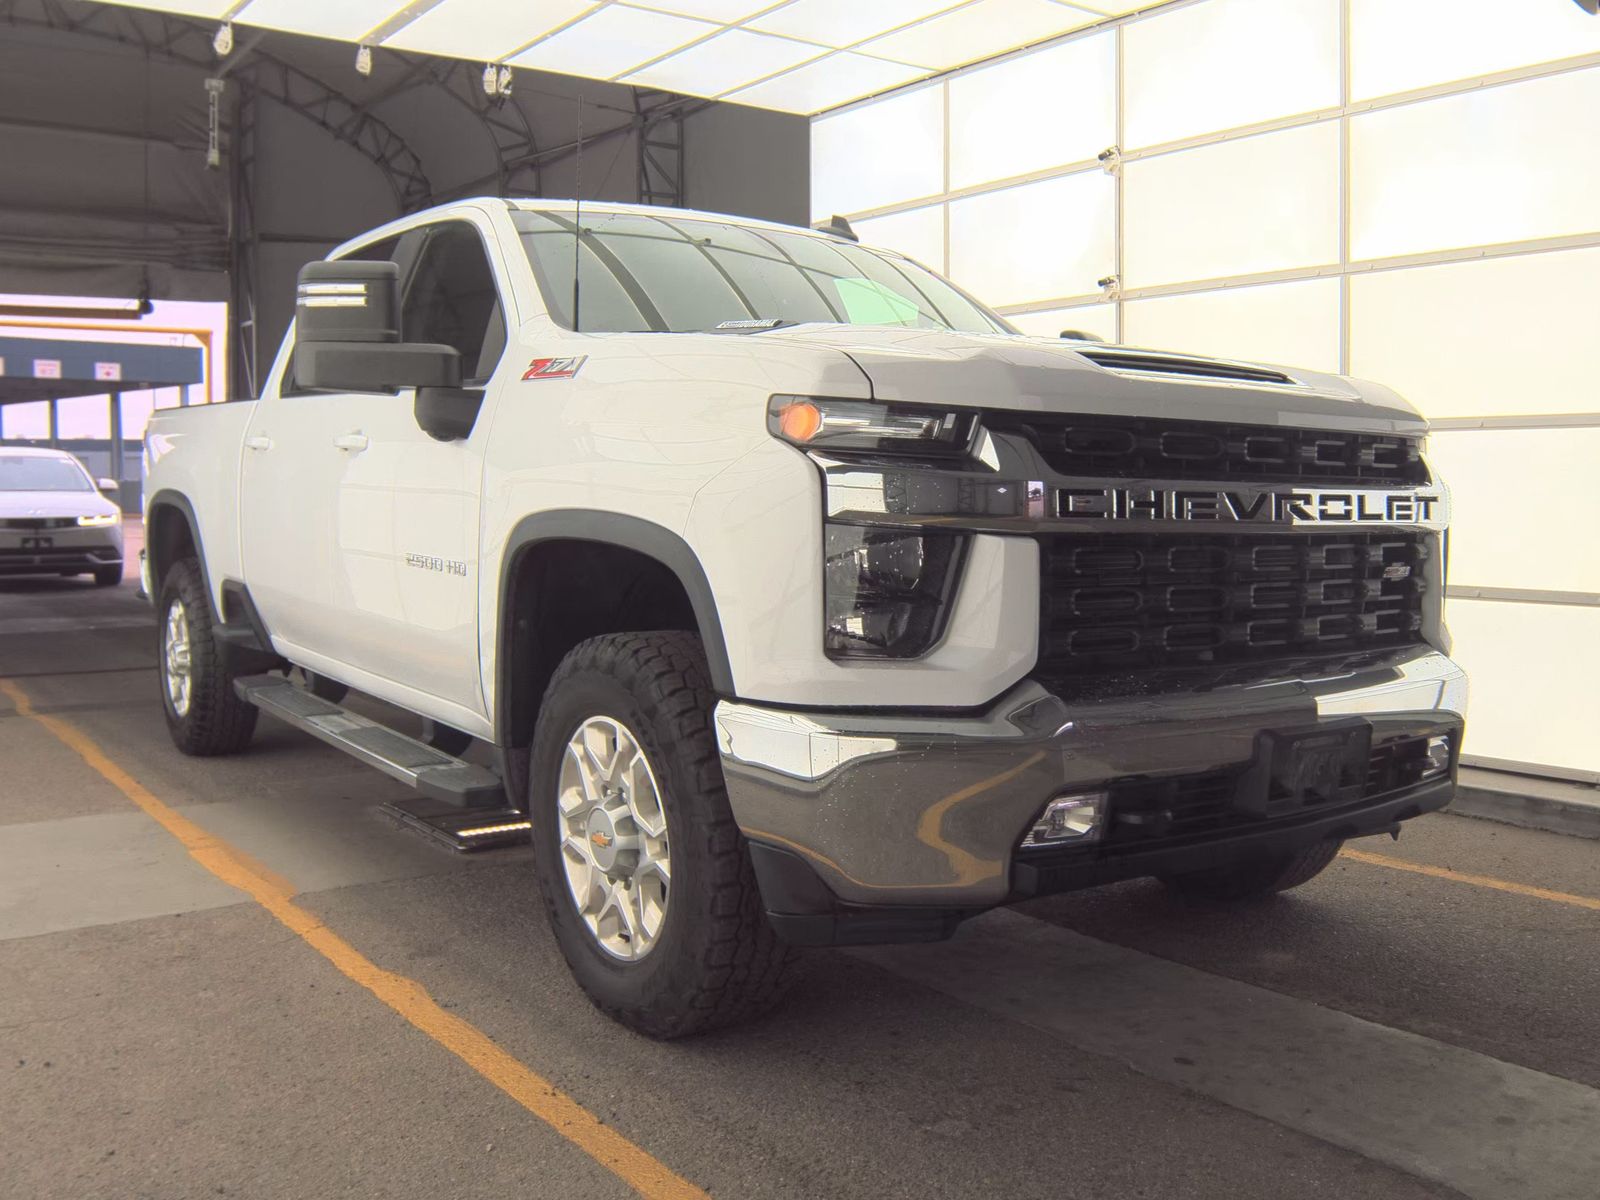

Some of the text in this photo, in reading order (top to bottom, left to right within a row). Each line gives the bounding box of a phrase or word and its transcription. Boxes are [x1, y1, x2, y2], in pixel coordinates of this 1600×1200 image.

[1055, 488, 1438, 521] CHEVROLET
[405, 552, 467, 576] 2500 HD
